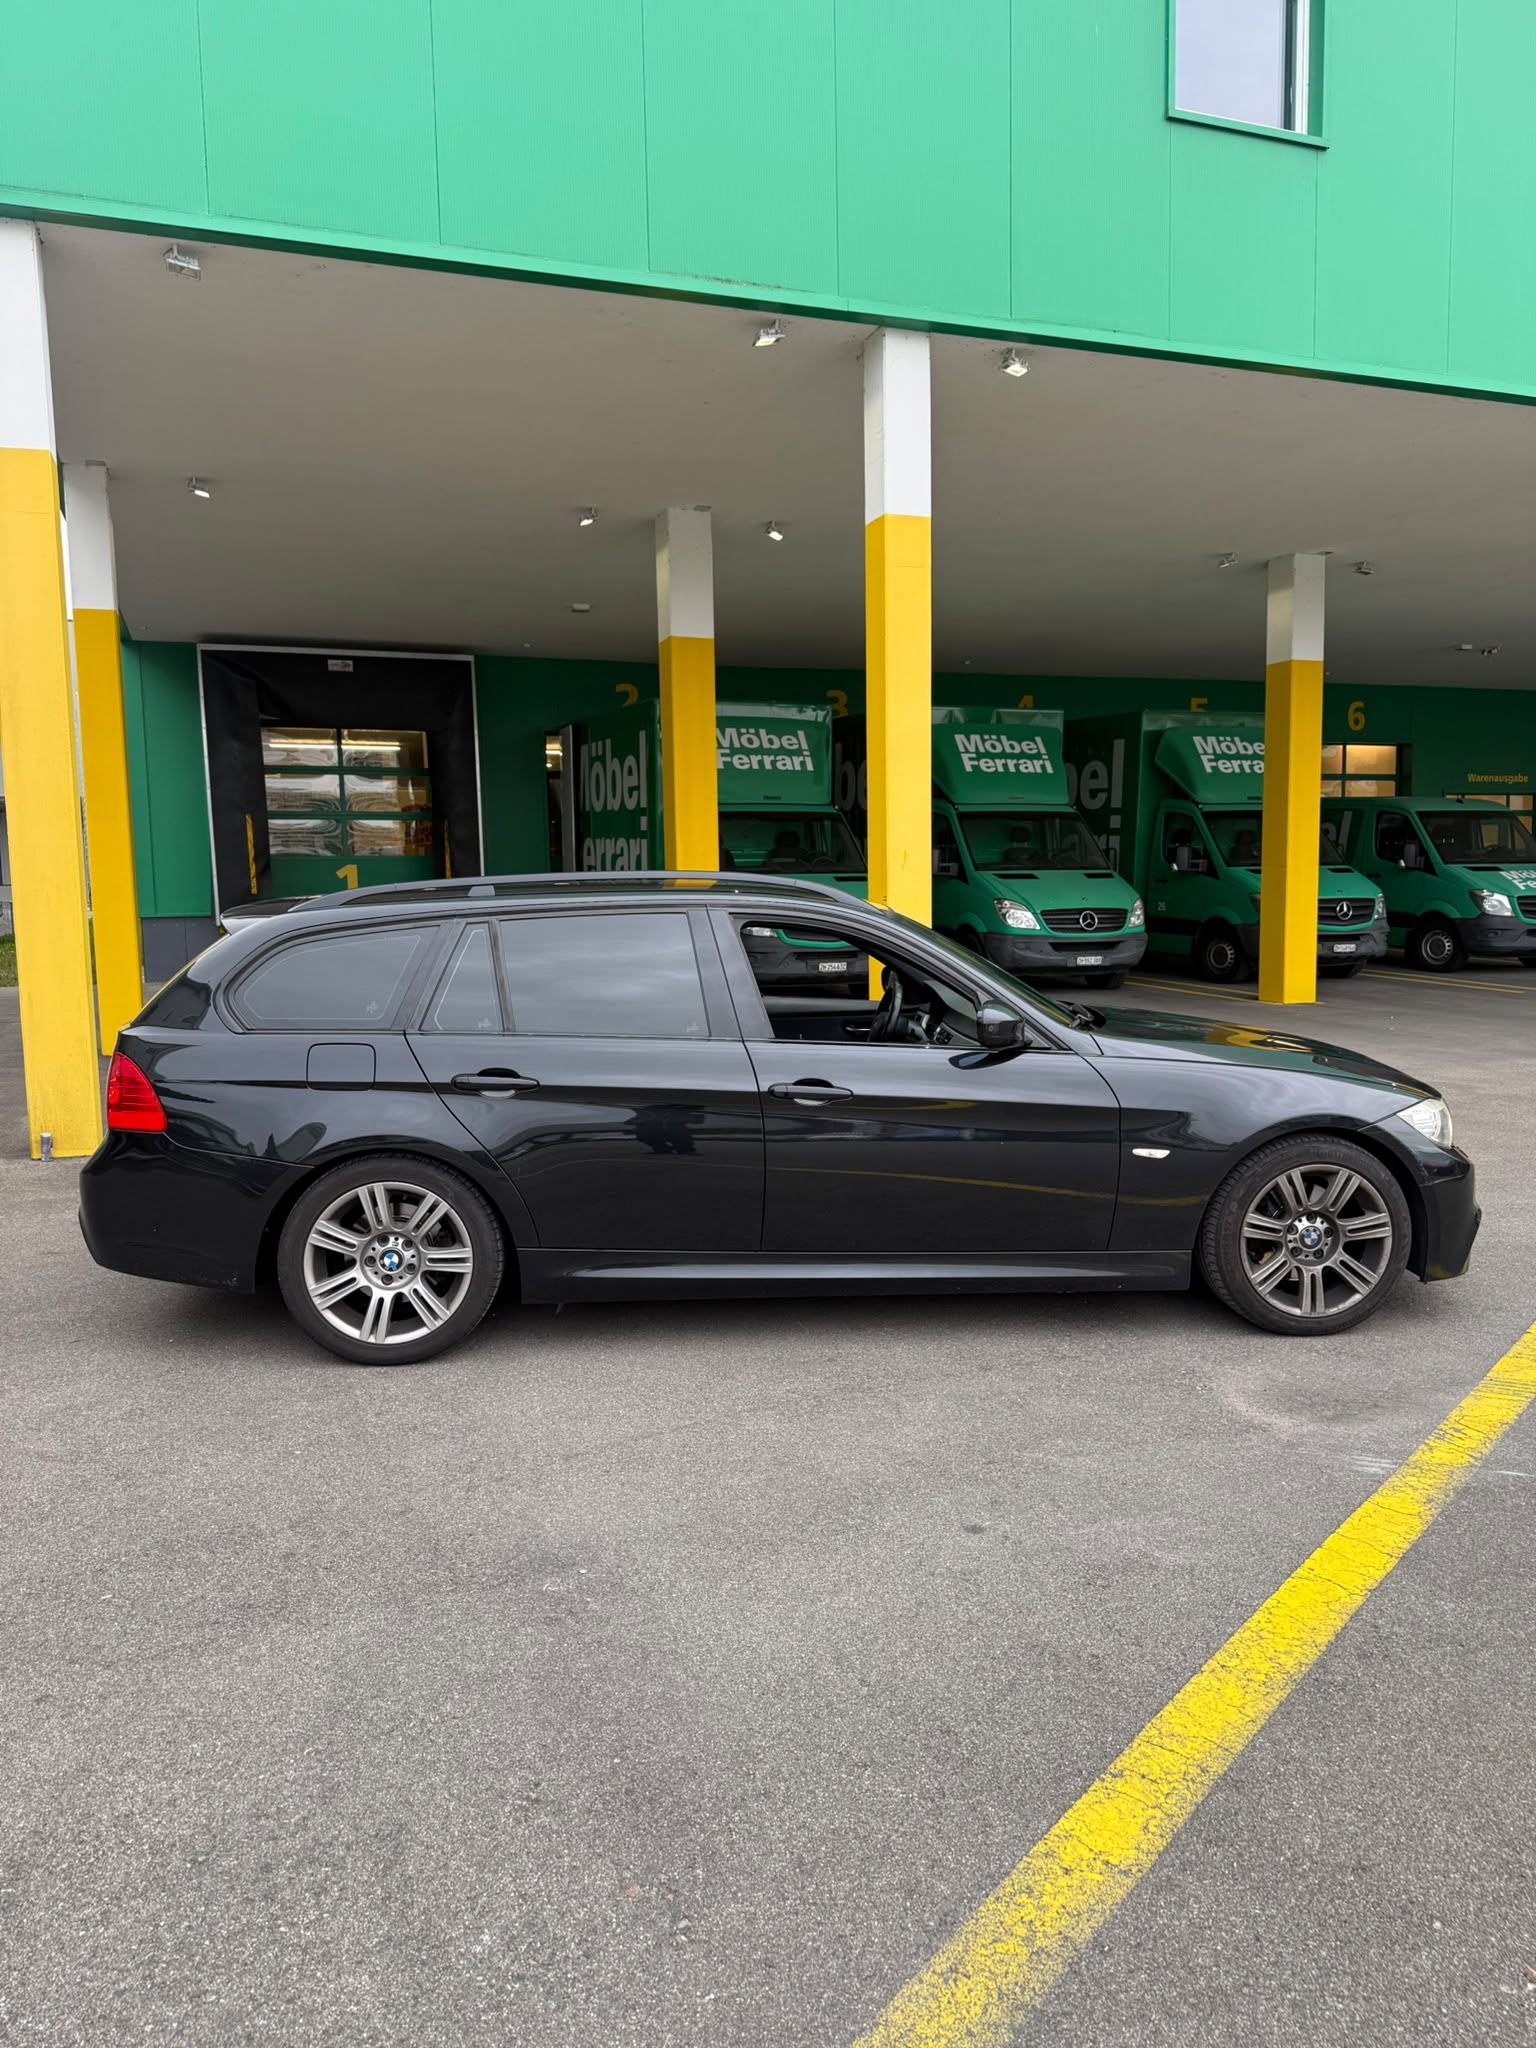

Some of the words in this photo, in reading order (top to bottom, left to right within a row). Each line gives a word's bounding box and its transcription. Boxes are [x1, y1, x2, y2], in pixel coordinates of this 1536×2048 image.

[826, 690, 848, 719] 3
[1347, 701, 1366, 732] 6
[716, 728, 809, 750] Möbel
[954, 734, 1047, 754] Möbel
[1192, 736, 1265, 755] Möbe
[716, 749, 815, 771] Ferrari
[960, 753, 1054, 774] Ferrari
[1200, 754, 1265, 774] Ferra
[1467, 773, 1529, 785] Warenausgabe
[583, 816, 648, 872] errari
[335, 864, 358, 890] 1
[1498, 870, 1536, 880] Mö
[1511, 879, 1536, 890] Fe
